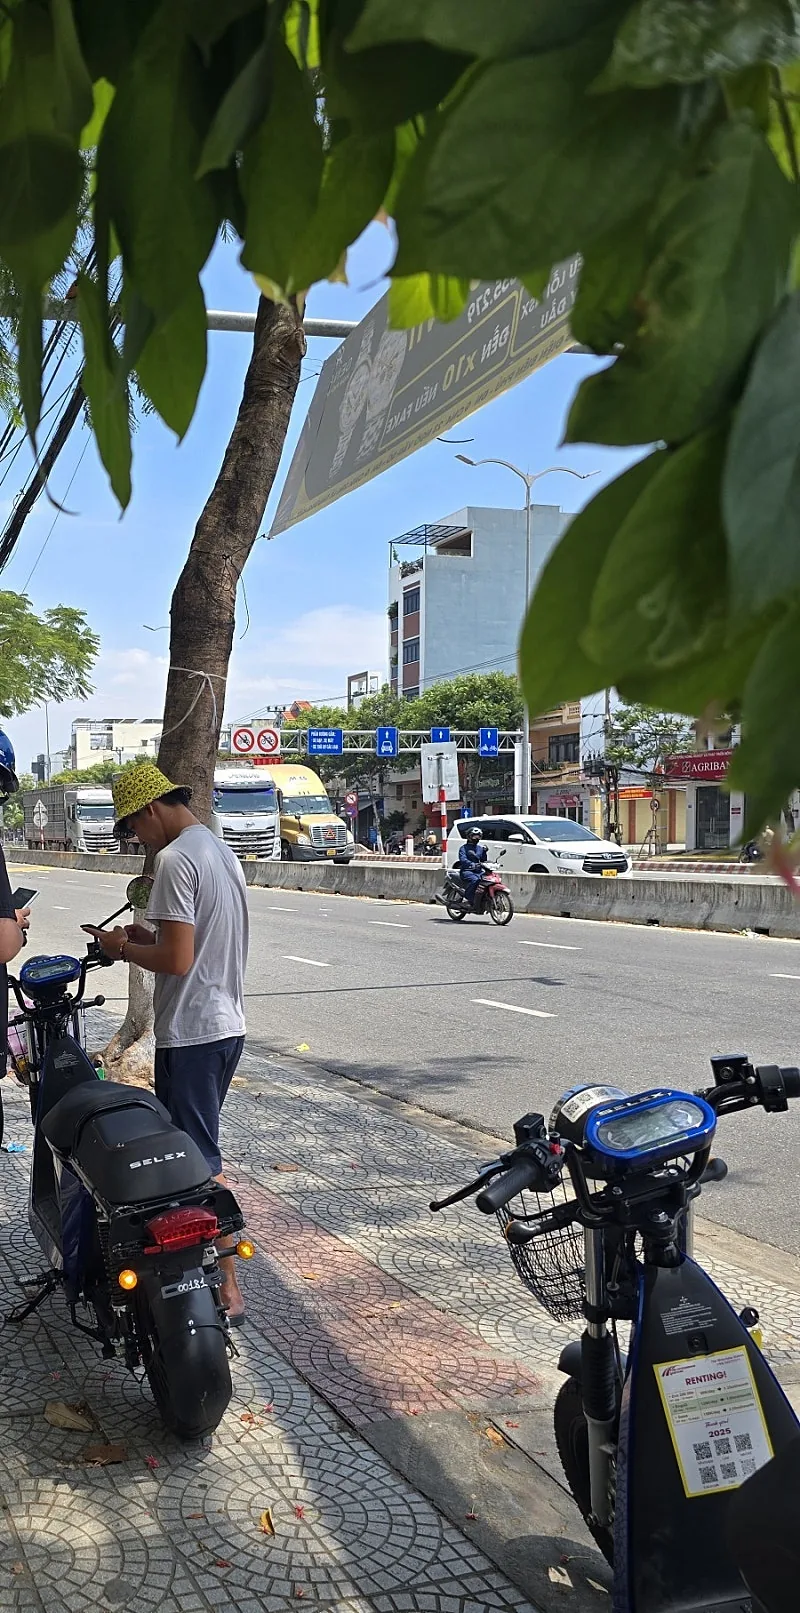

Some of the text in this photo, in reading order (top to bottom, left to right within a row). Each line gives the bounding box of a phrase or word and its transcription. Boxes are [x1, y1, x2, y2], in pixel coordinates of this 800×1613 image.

[597, 1092, 665, 1116] SELEX
[129, 1151, 187, 1170] SELEX
[685, 1371, 728, 1386] RENTING!
[708, 1427, 731, 1438] 2025
